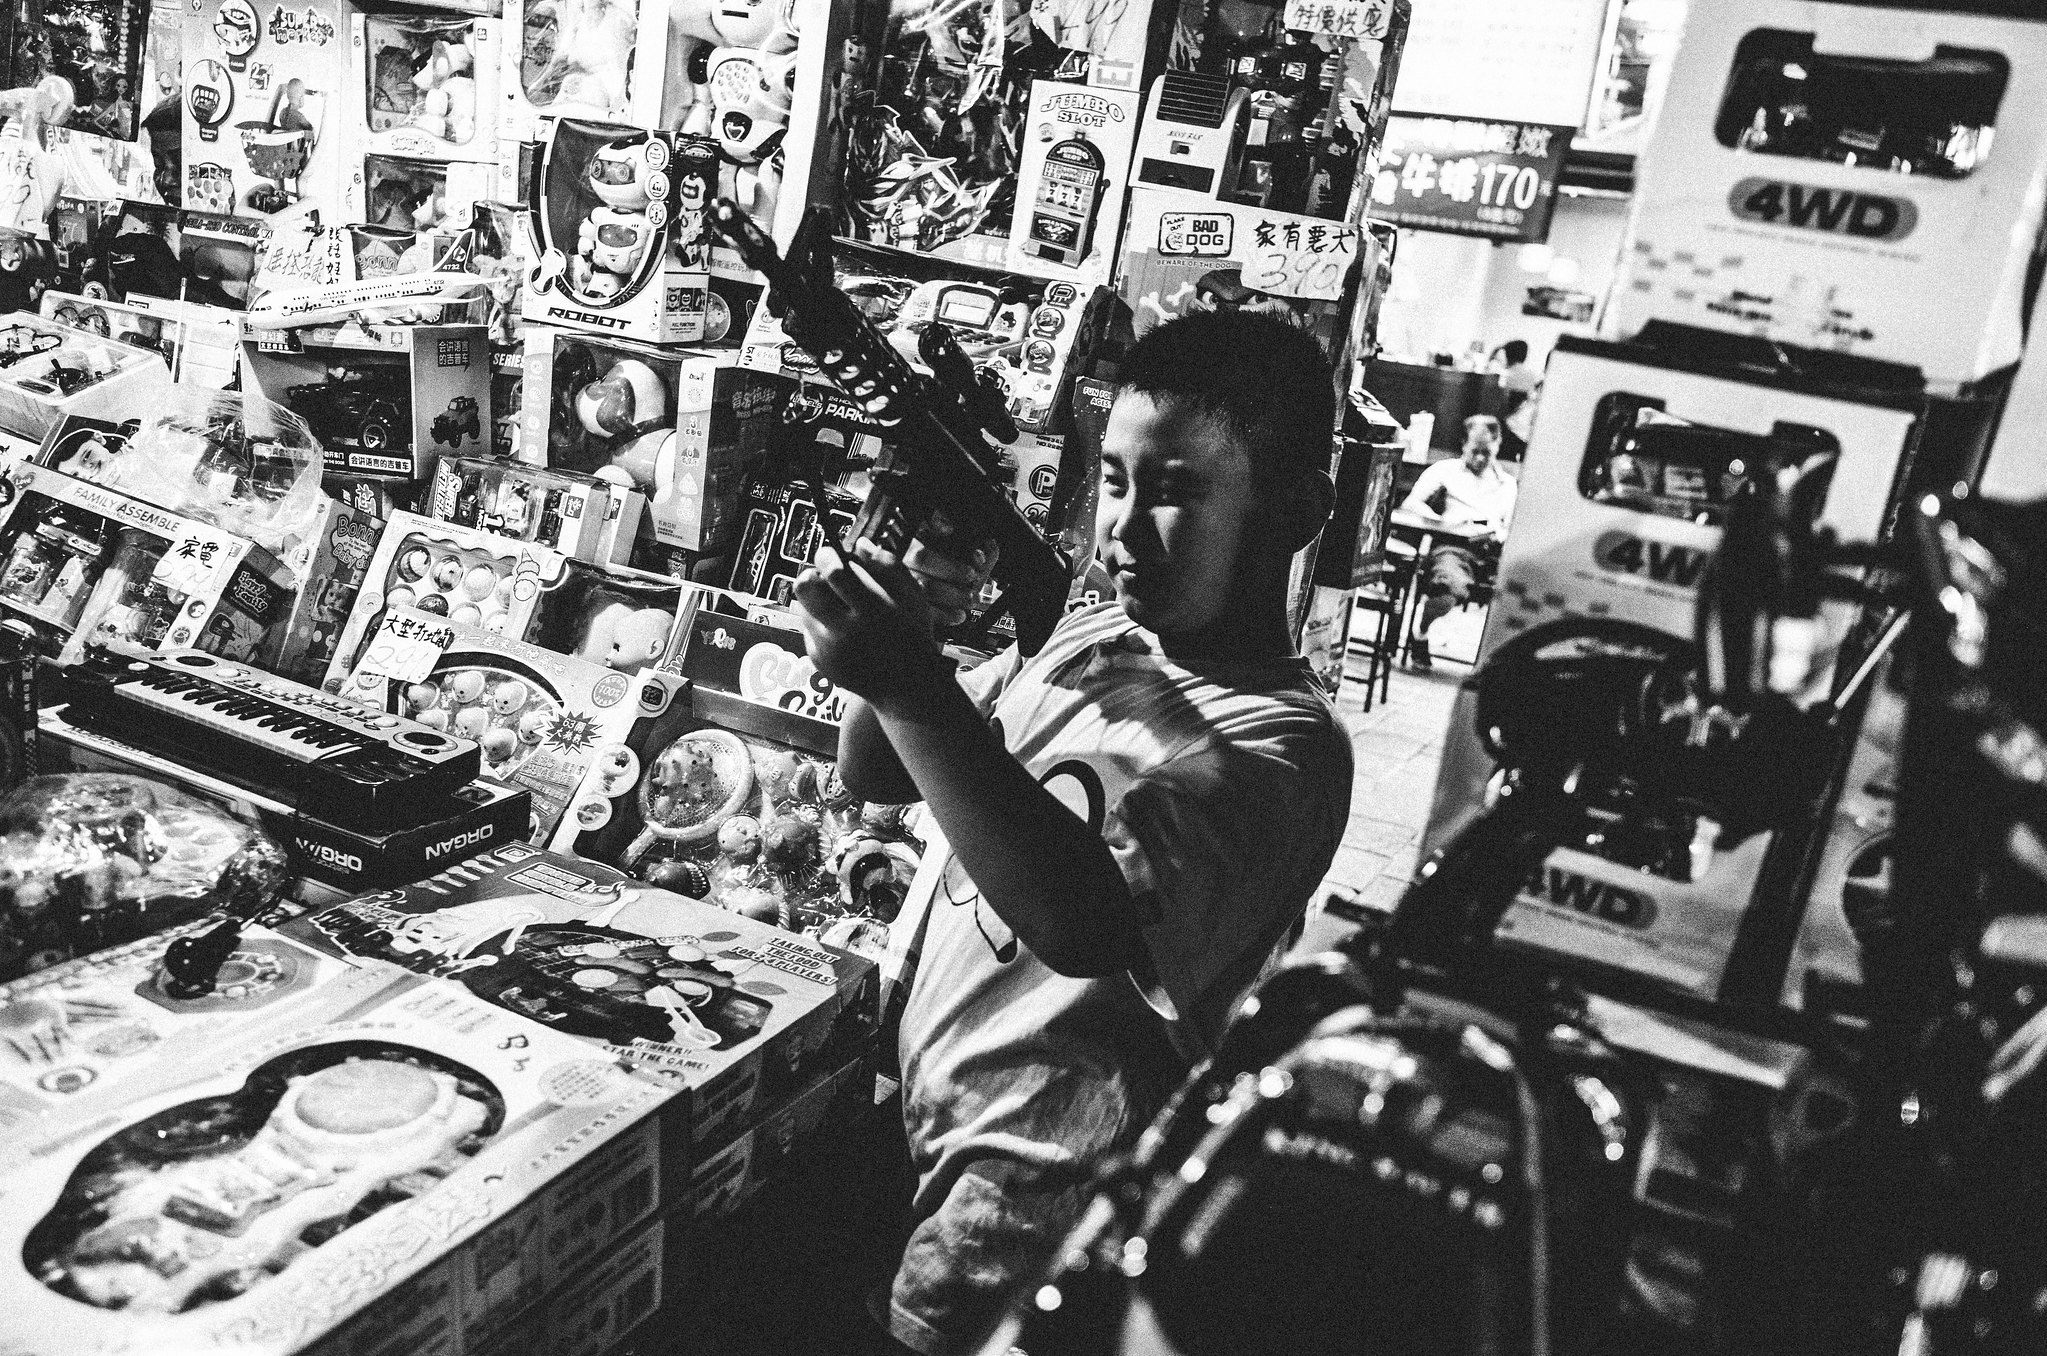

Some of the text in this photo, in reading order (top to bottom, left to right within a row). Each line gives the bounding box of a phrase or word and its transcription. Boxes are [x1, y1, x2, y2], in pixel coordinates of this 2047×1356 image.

[1040, 93, 1125, 122] JUMBO
[1057, 110, 1107, 128] SLOT
[1478, 162, 1540, 210] 170
[1745, 181, 1900, 238] 4WD
[1192, 219, 1219, 233] BAD
[1185, 234, 1224, 246] DOG
[1199, 261, 1214, 269] THE
[547, 306, 632, 330] ROBOT
[1083, 386, 1099, 397] FUN
[73, 487, 117, 510] FAMILY
[116, 502, 181, 534] ASSEMBLE
[176, 535, 219, 569] 家電
[332, 543, 357, 569] Baby
[425, 823, 494, 861] ORGAN
[767, 946, 822, 969] THE FOOD
[770, 937, 838, 963] TAKING OUT
